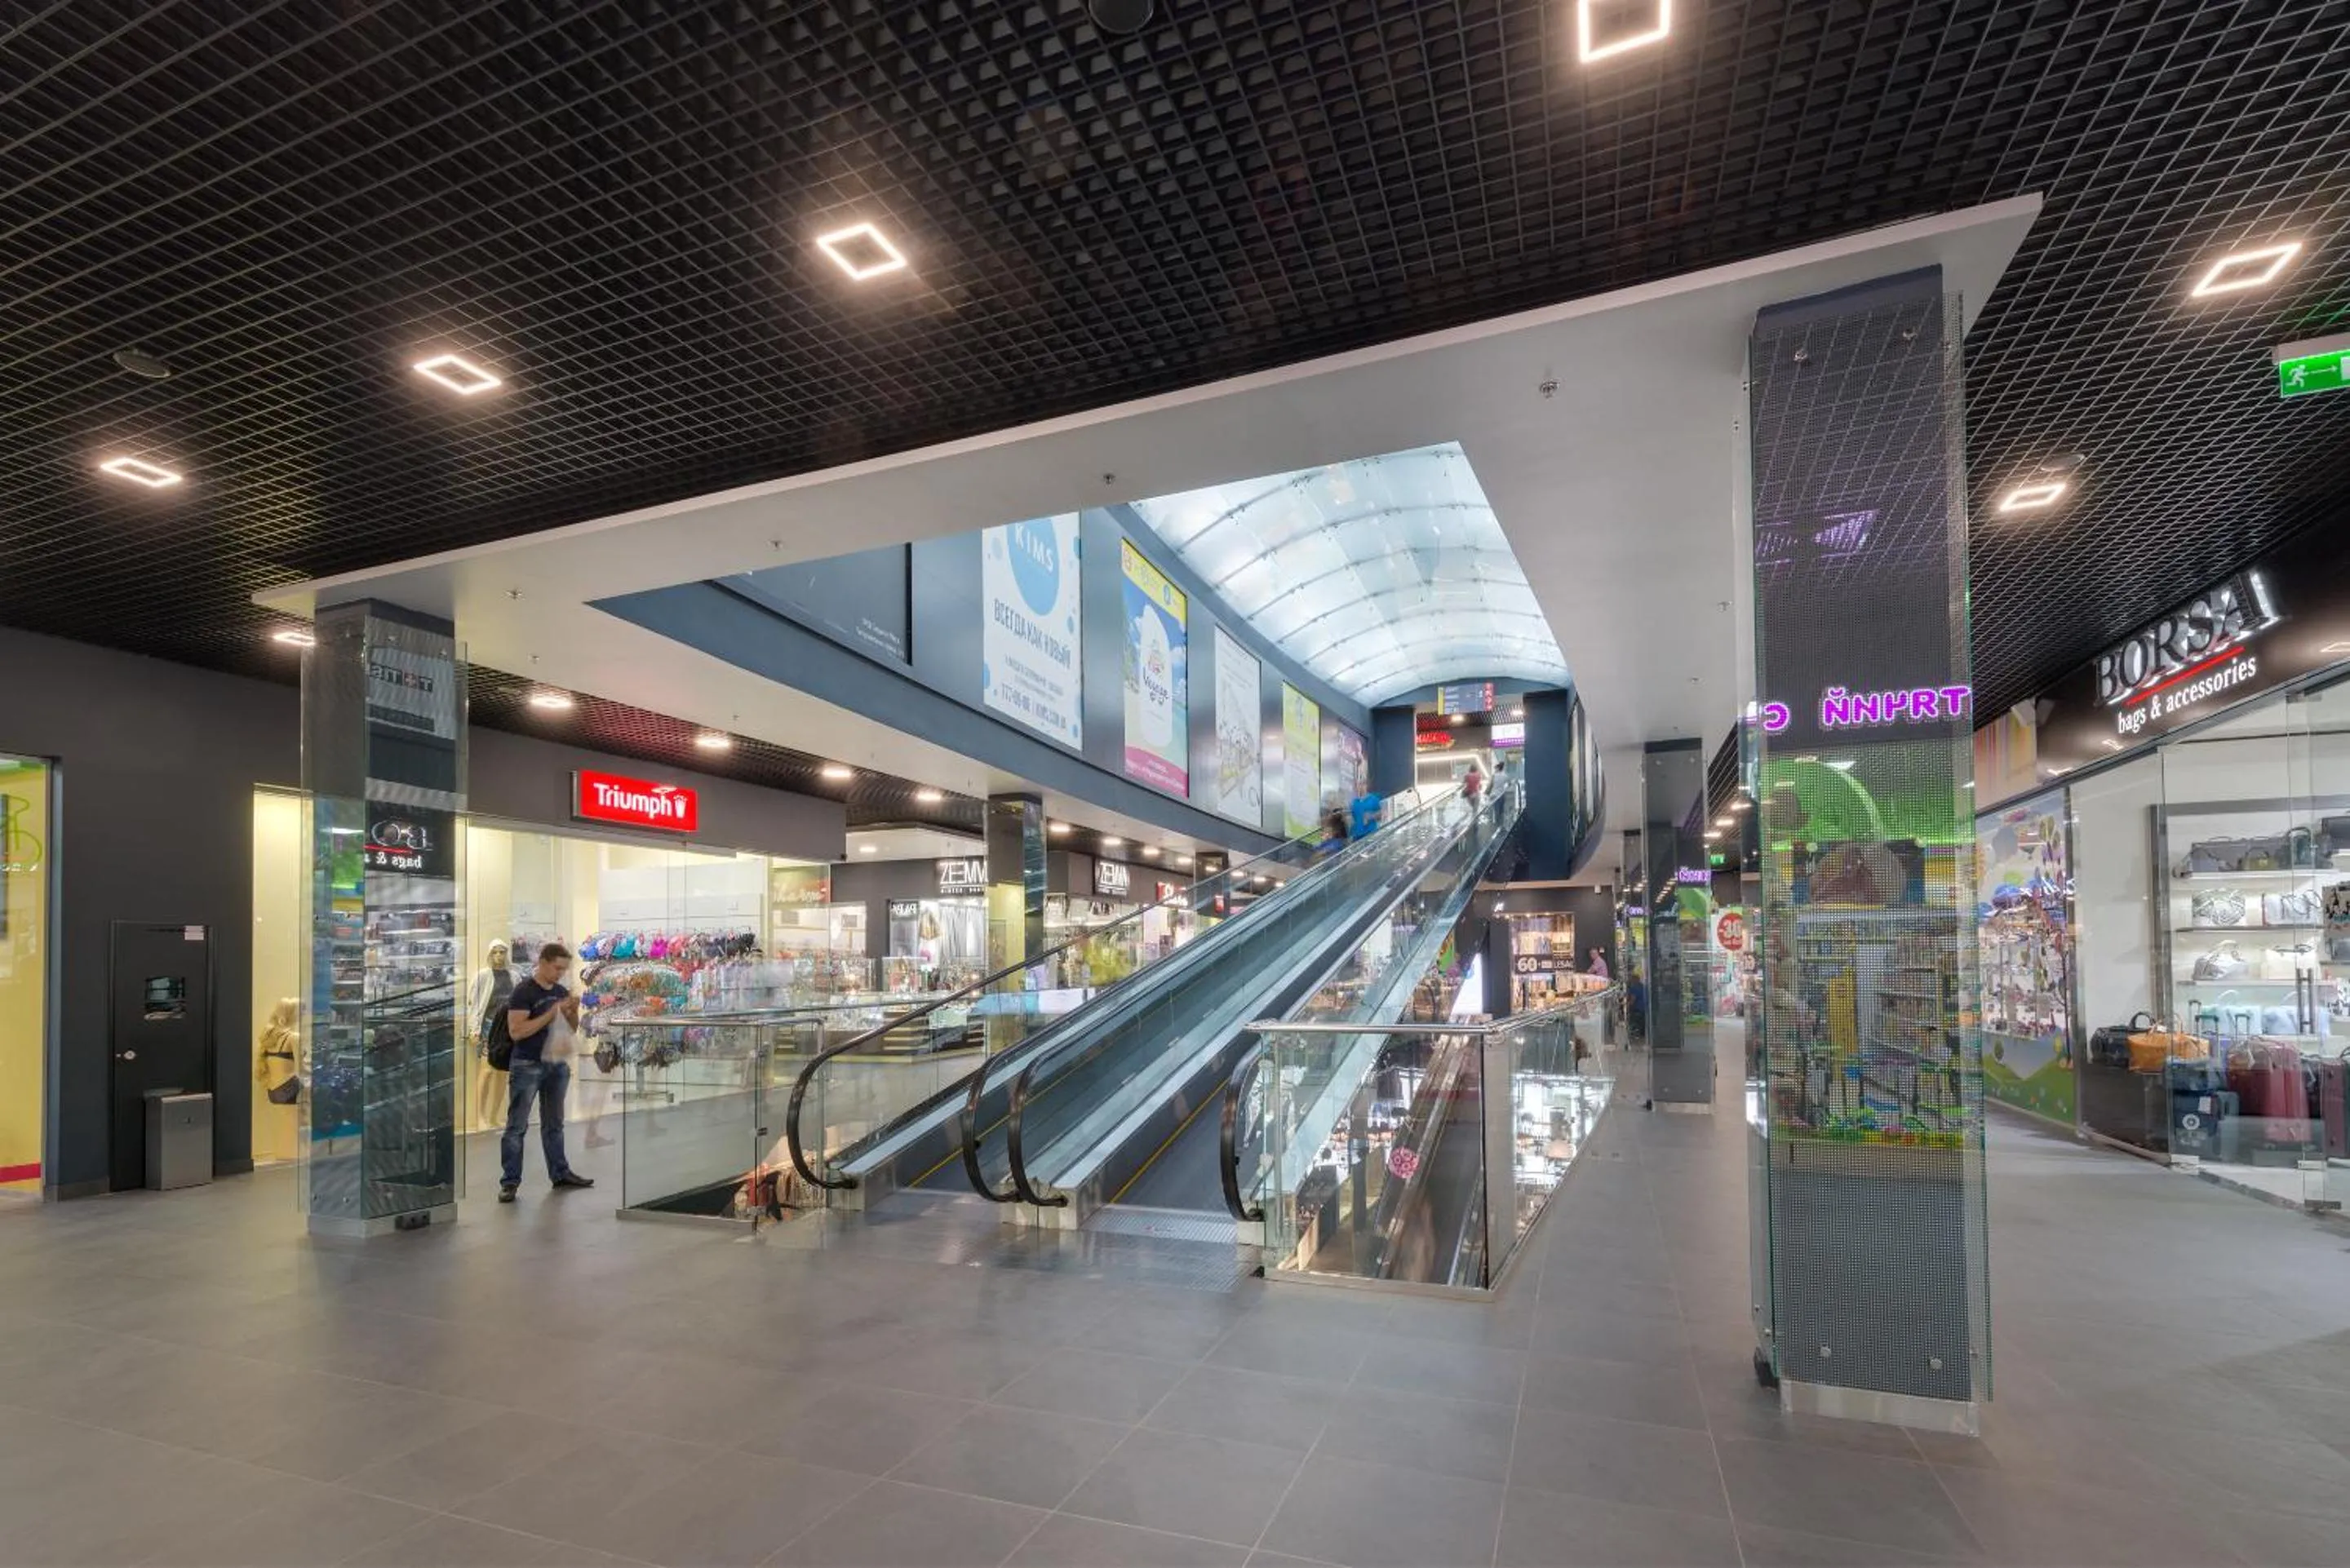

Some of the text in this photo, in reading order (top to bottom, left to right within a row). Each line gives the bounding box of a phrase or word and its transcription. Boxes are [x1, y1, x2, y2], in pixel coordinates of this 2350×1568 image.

[1014, 523, 1053, 573] KIMS
[2117, 656, 2257, 734] bags & accessories
[593, 782, 672, 819] Triumph
